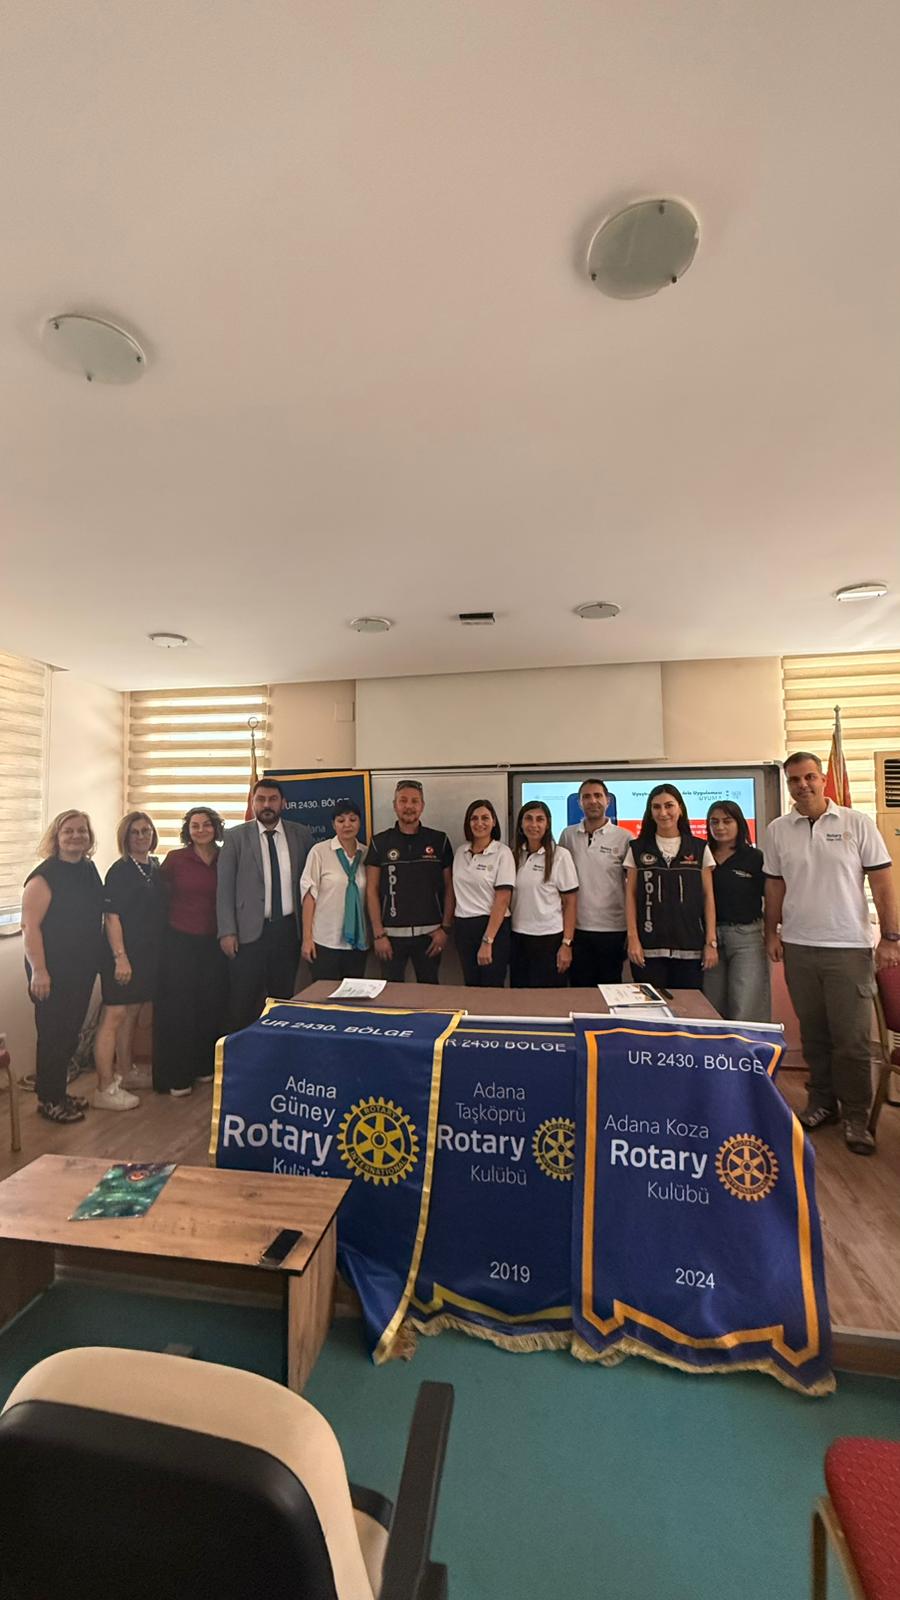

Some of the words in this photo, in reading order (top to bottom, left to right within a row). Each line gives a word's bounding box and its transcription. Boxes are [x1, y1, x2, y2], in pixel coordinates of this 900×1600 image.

[285, 802, 297, 810] UR
[260, 1018, 290, 1028] UR
[290, 1021, 337, 1032] 2430.
[343, 1025, 414, 1039] BÖLGE
[628, 1050, 653, 1066] UR
[657, 1052, 699, 1069] 2430.
[704, 1053, 764, 1075] BÖLGE
[285, 1075, 337, 1099] Adana
[473, 1082, 526, 1101] Adana
[270, 1094, 336, 1128] Güney
[455, 1102, 526, 1124] Taşköprü
[604, 1114, 661, 1135] Adana
[666, 1118, 709, 1139] Koza
[223, 1114, 334, 1167] Rotary
[437, 1124, 526, 1162] Rotary
[610, 1138, 708, 1179] Rotary
[471, 1165, 528, 1185] Kulübü
[647, 1181, 710, 1205] Kulübü
[490, 1261, 531, 1284] 2019
[675, 1267, 716, 1290] 2024
